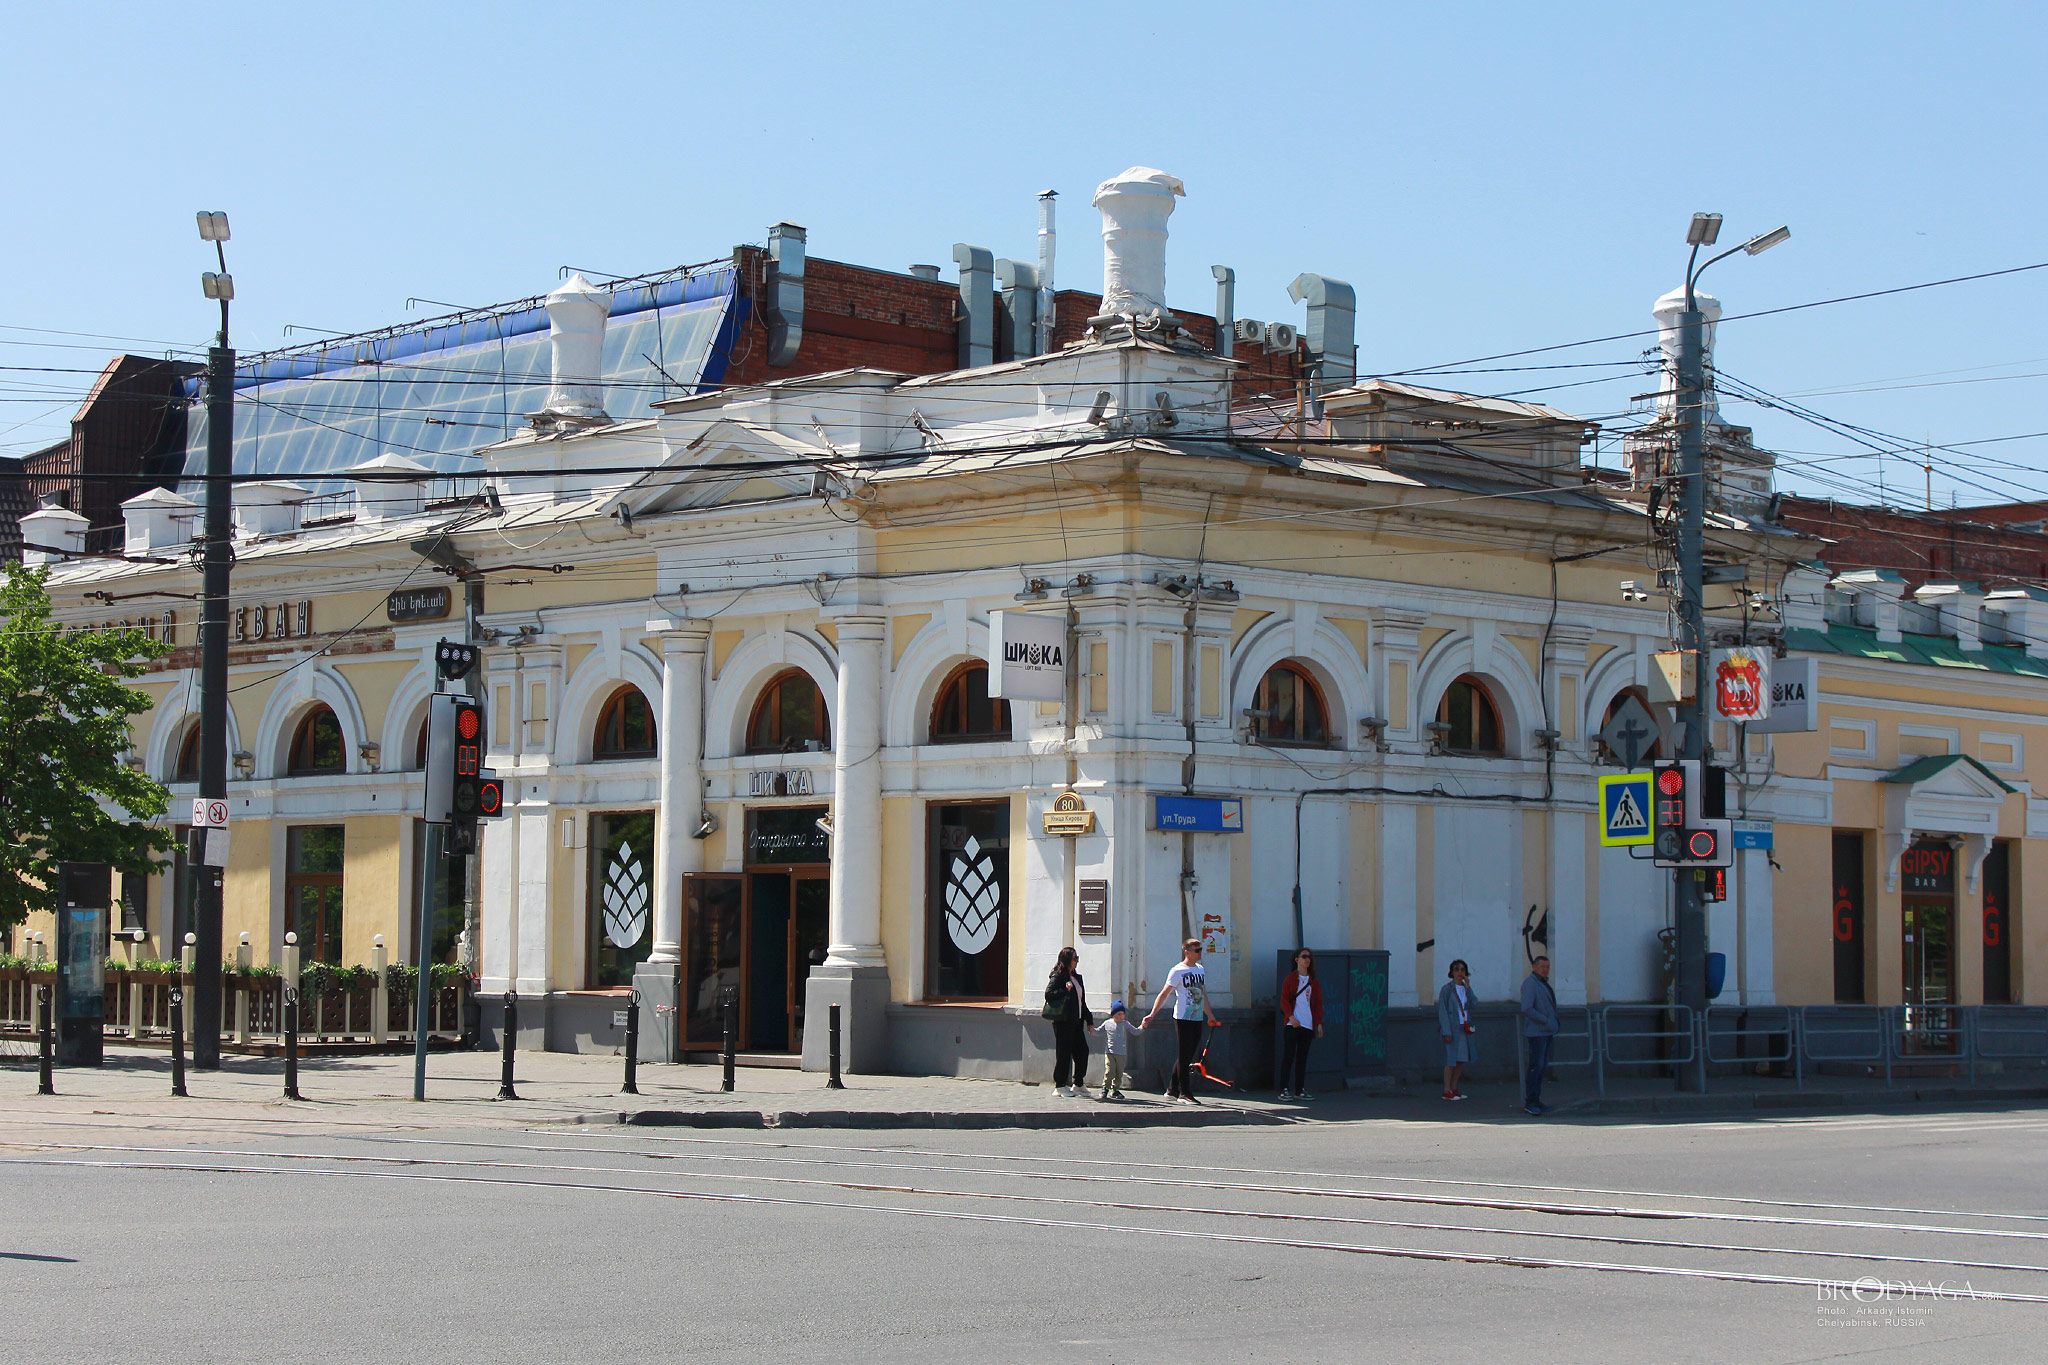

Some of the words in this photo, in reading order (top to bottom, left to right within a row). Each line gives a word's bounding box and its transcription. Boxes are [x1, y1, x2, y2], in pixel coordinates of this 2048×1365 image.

[1062, 800, 1073, 810] 80
[1661, 800, 1683, 826] 33
[1902, 849, 1950, 875] GIPSY
[1915, 877, 1937, 887] BAR
[1833, 900, 1853, 941] G
[1982, 906, 1999, 946] G
